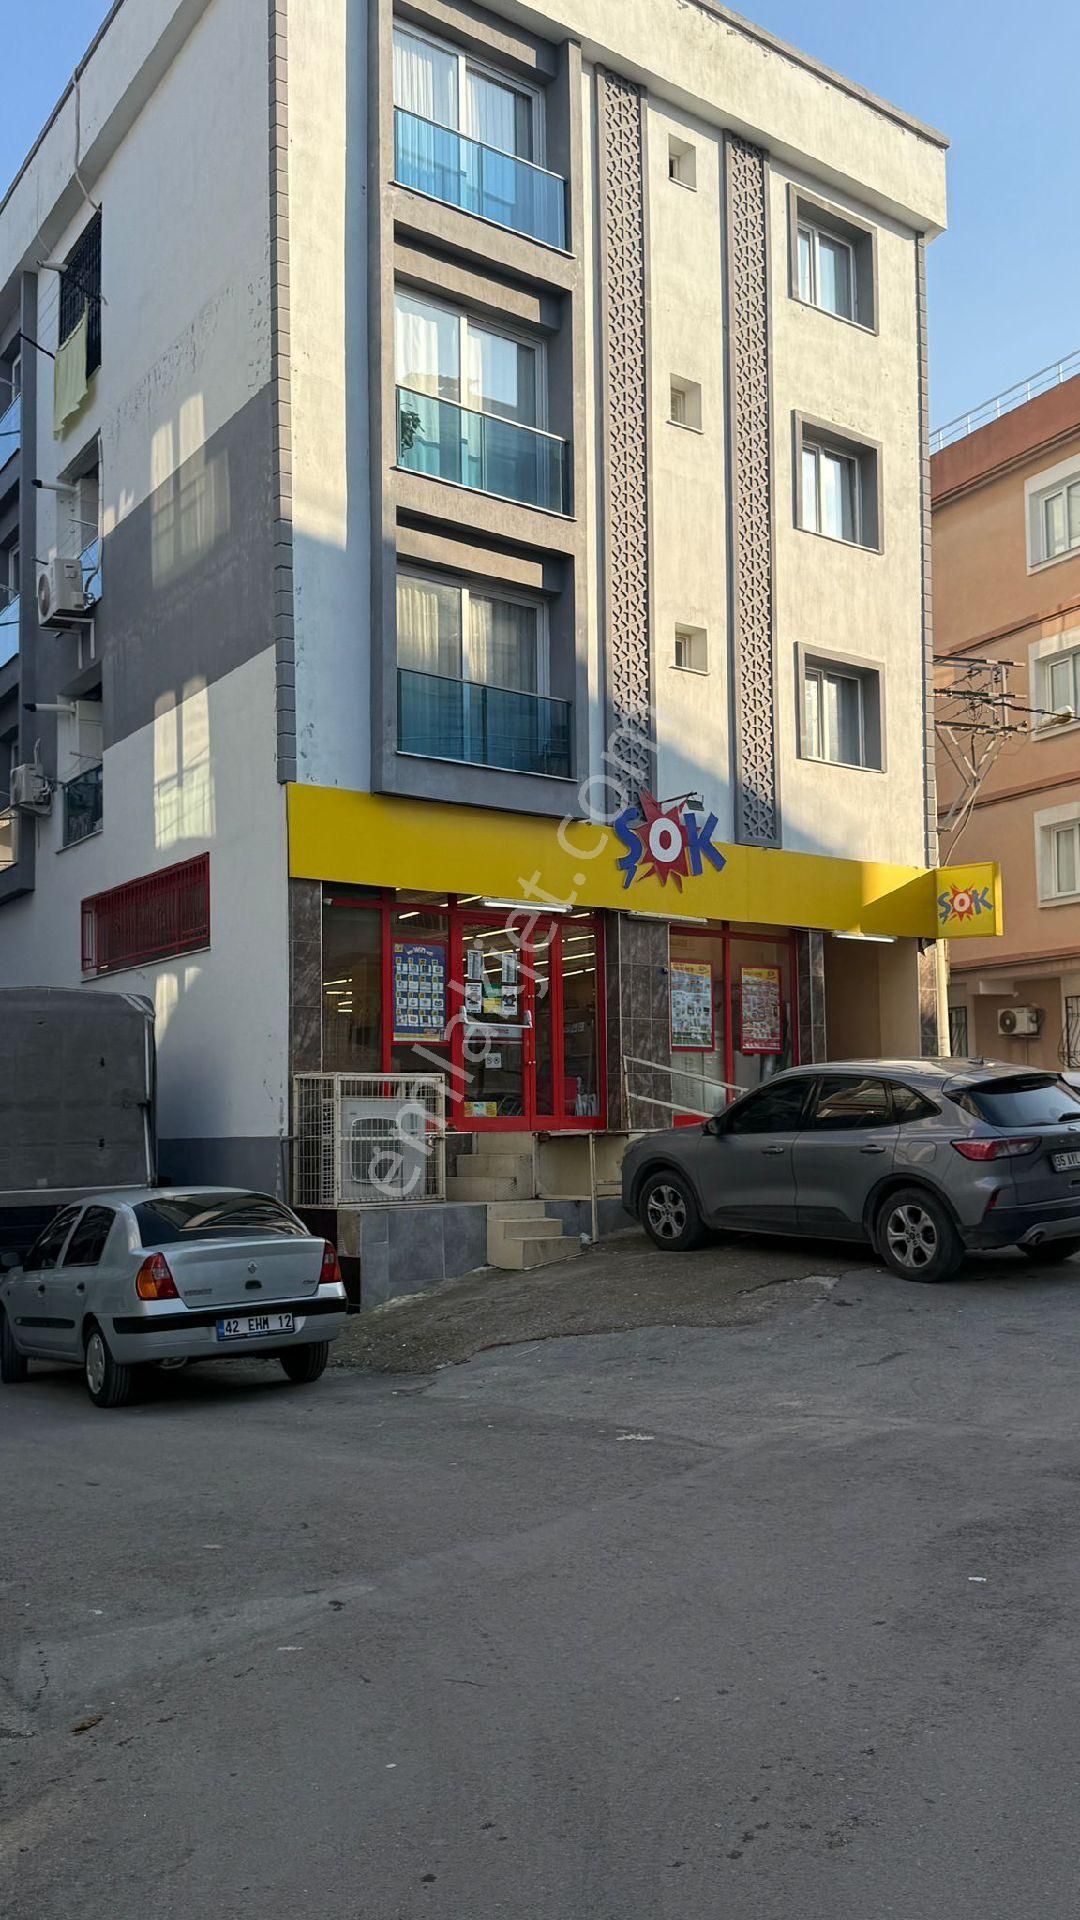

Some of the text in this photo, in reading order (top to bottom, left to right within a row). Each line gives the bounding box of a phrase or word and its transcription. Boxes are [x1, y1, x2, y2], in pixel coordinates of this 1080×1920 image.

[614, 807, 727, 890] ŞOK
[937, 886, 994, 925] ŞOK
[1055, 1154, 1066, 1167] 35
[225, 1314, 292, 1333] 42 EHM 12
